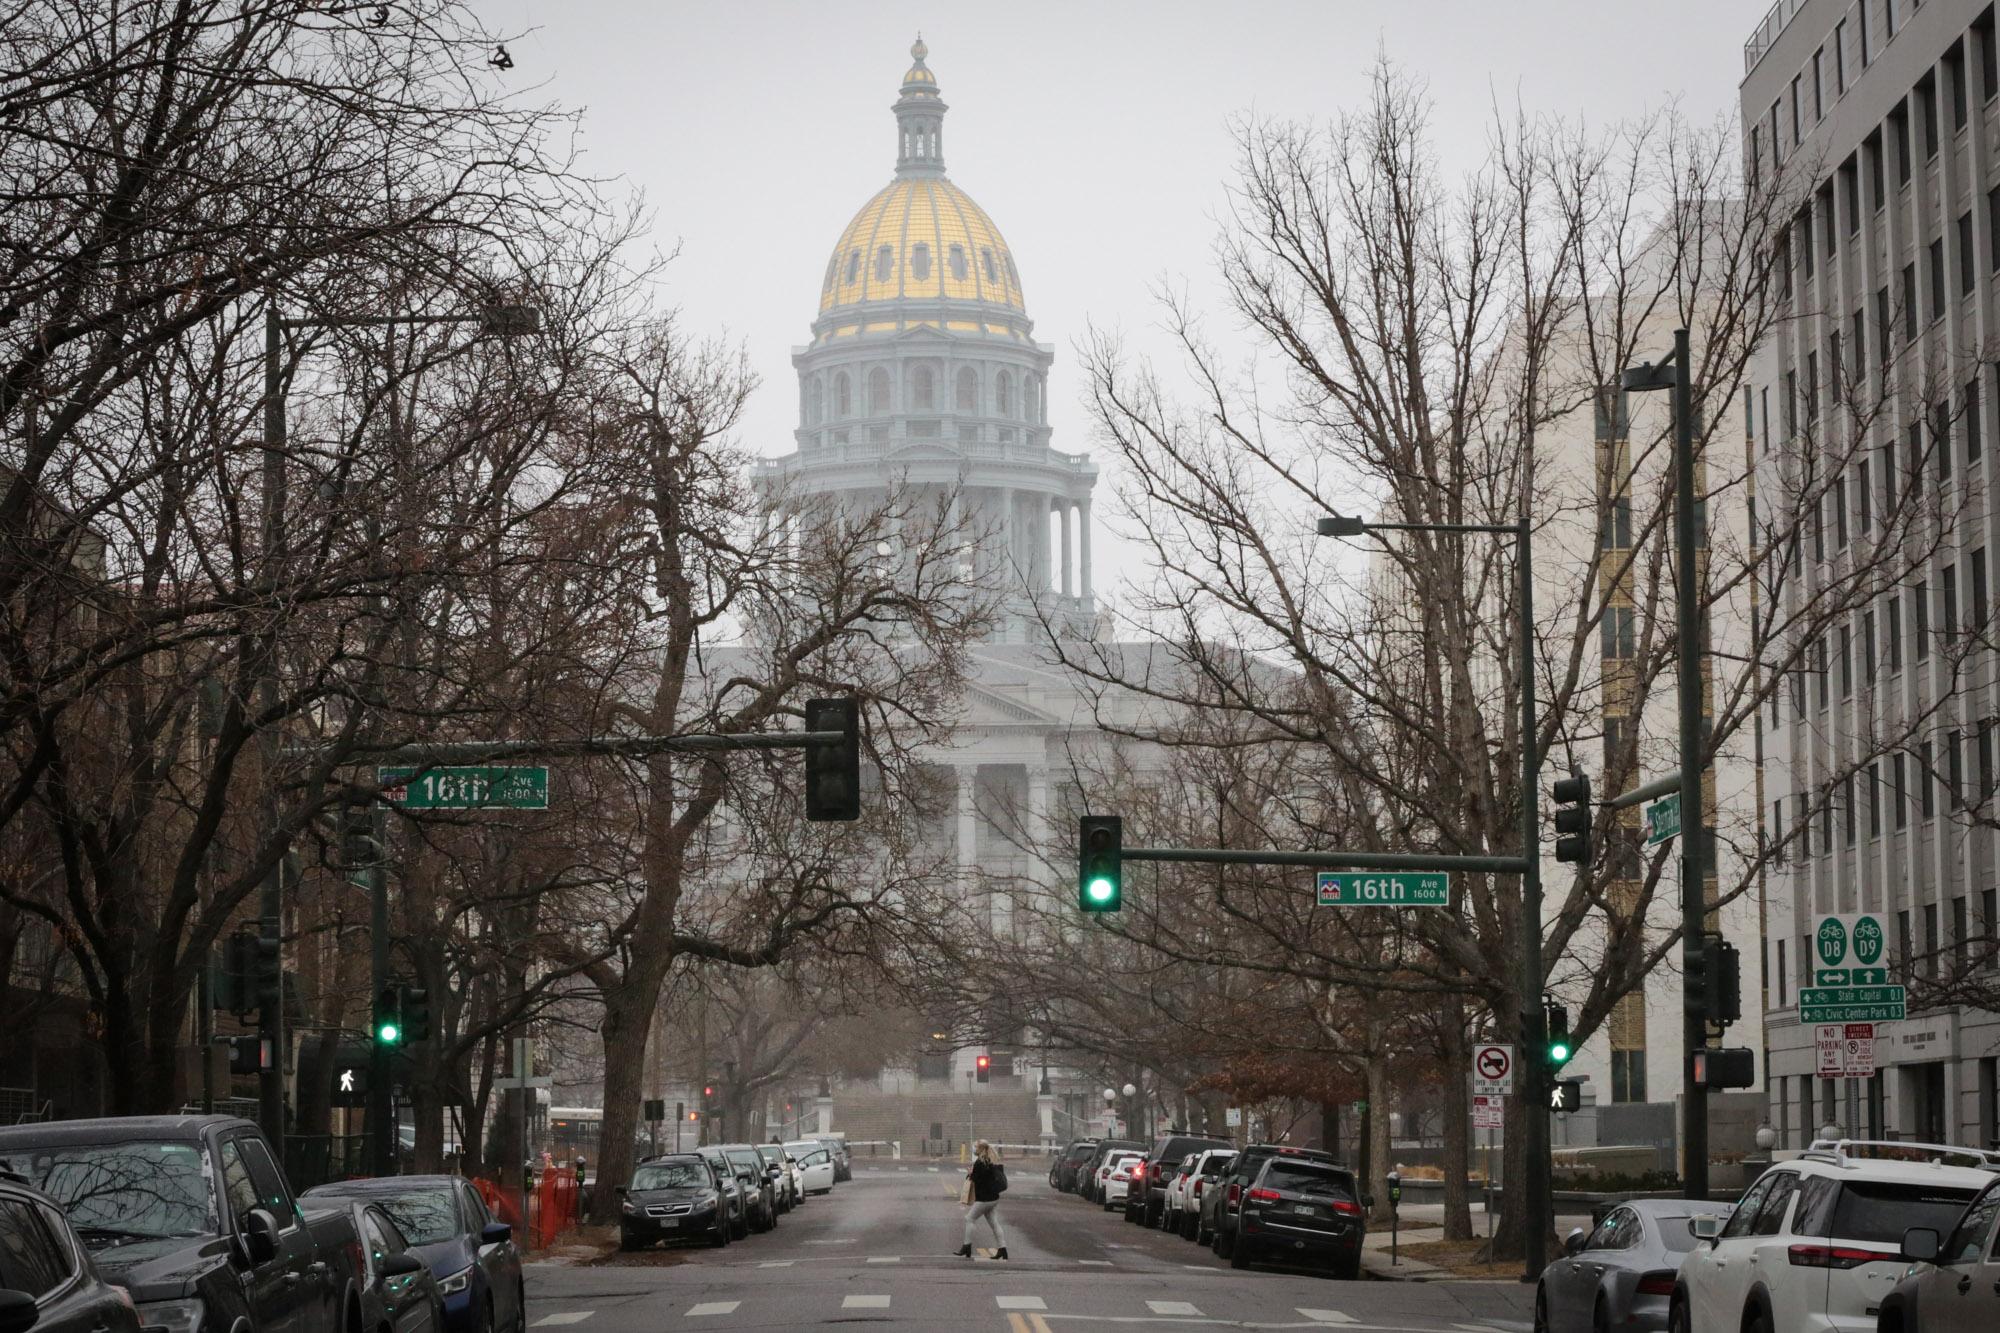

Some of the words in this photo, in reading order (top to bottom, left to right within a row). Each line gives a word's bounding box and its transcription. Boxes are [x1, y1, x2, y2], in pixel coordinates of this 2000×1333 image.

[423, 774, 491, 801] 16th
[512, 776, 533, 786] Ave
[1352, 878, 1405, 900] 16th
[1421, 879, 1438, 888] Ave
[1413, 890, 1436, 899] 1600
[1439, 890, 1446, 899] N
[1824, 941, 1842, 958] D8
[1859, 940, 1877, 957] D9
[1838, 989, 1855, 1002] State
[1890, 990, 1901, 1001] 0.1
[1825, 1008, 1843, 1020] Civic
[1845, 1007, 1869, 1020] Center
[1870, 1007, 1887, 1018] Park
[1890, 1007, 1902, 1018] 0.3
[1823, 1028, 1835, 1039] NO
[1817, 1040, 1842, 1050] PARKING
